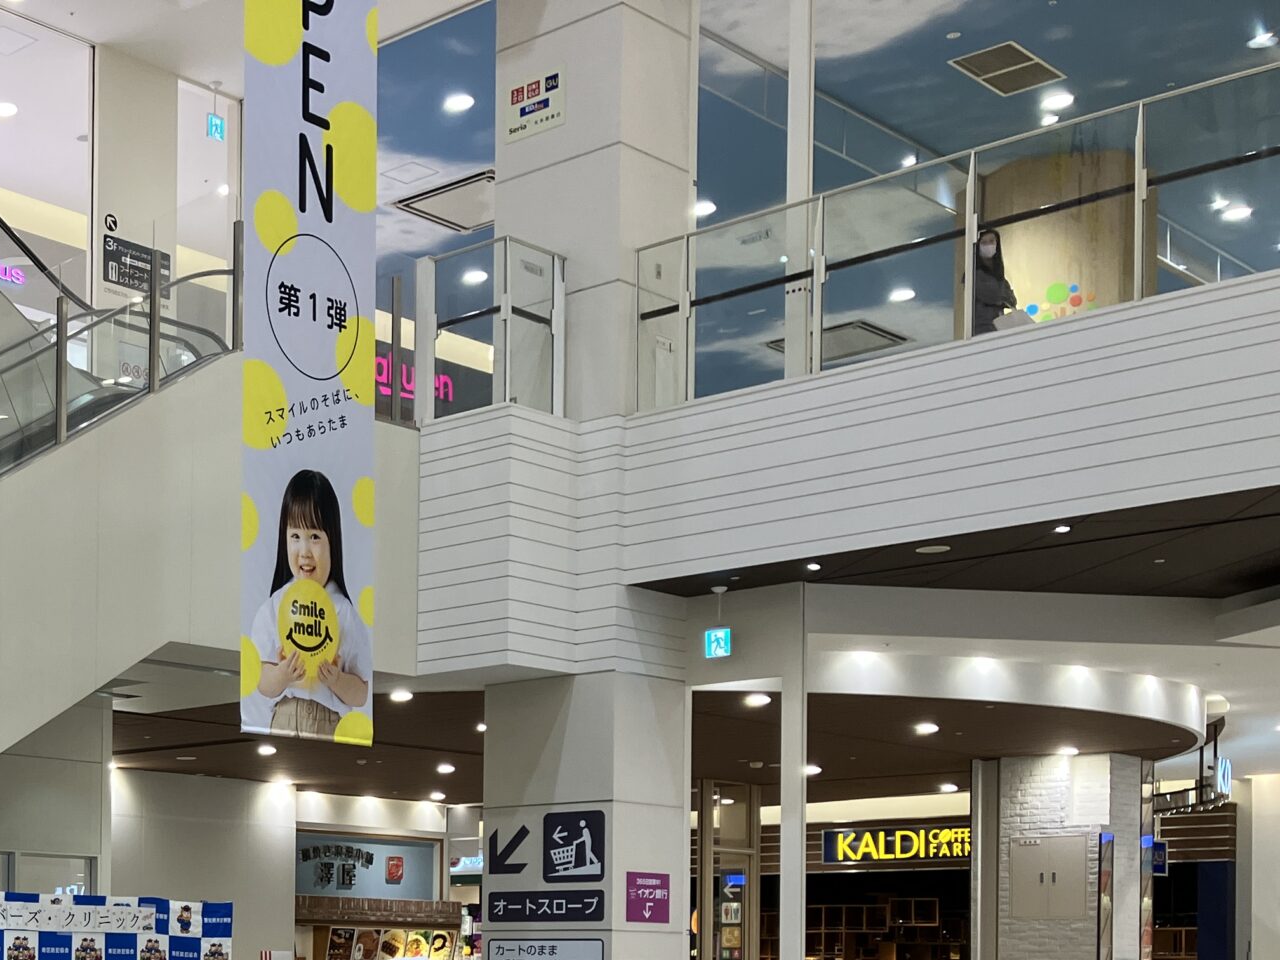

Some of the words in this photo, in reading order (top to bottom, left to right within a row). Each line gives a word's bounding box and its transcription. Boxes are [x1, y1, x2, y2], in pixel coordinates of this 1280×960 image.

[508, 123, 527, 135] Seria
[105, 238, 118, 251] 3F
[264, 388, 360, 425] スマイルのそばに、
[270, 415, 348, 449] いつもあらたま
[291, 600, 325, 620] Smile
[294, 619, 322, 637] mall
[837, 829, 925, 861] KALDI
[494, 897, 599, 915] オートスロープ
[495, 945, 558, 956] カートのまま
